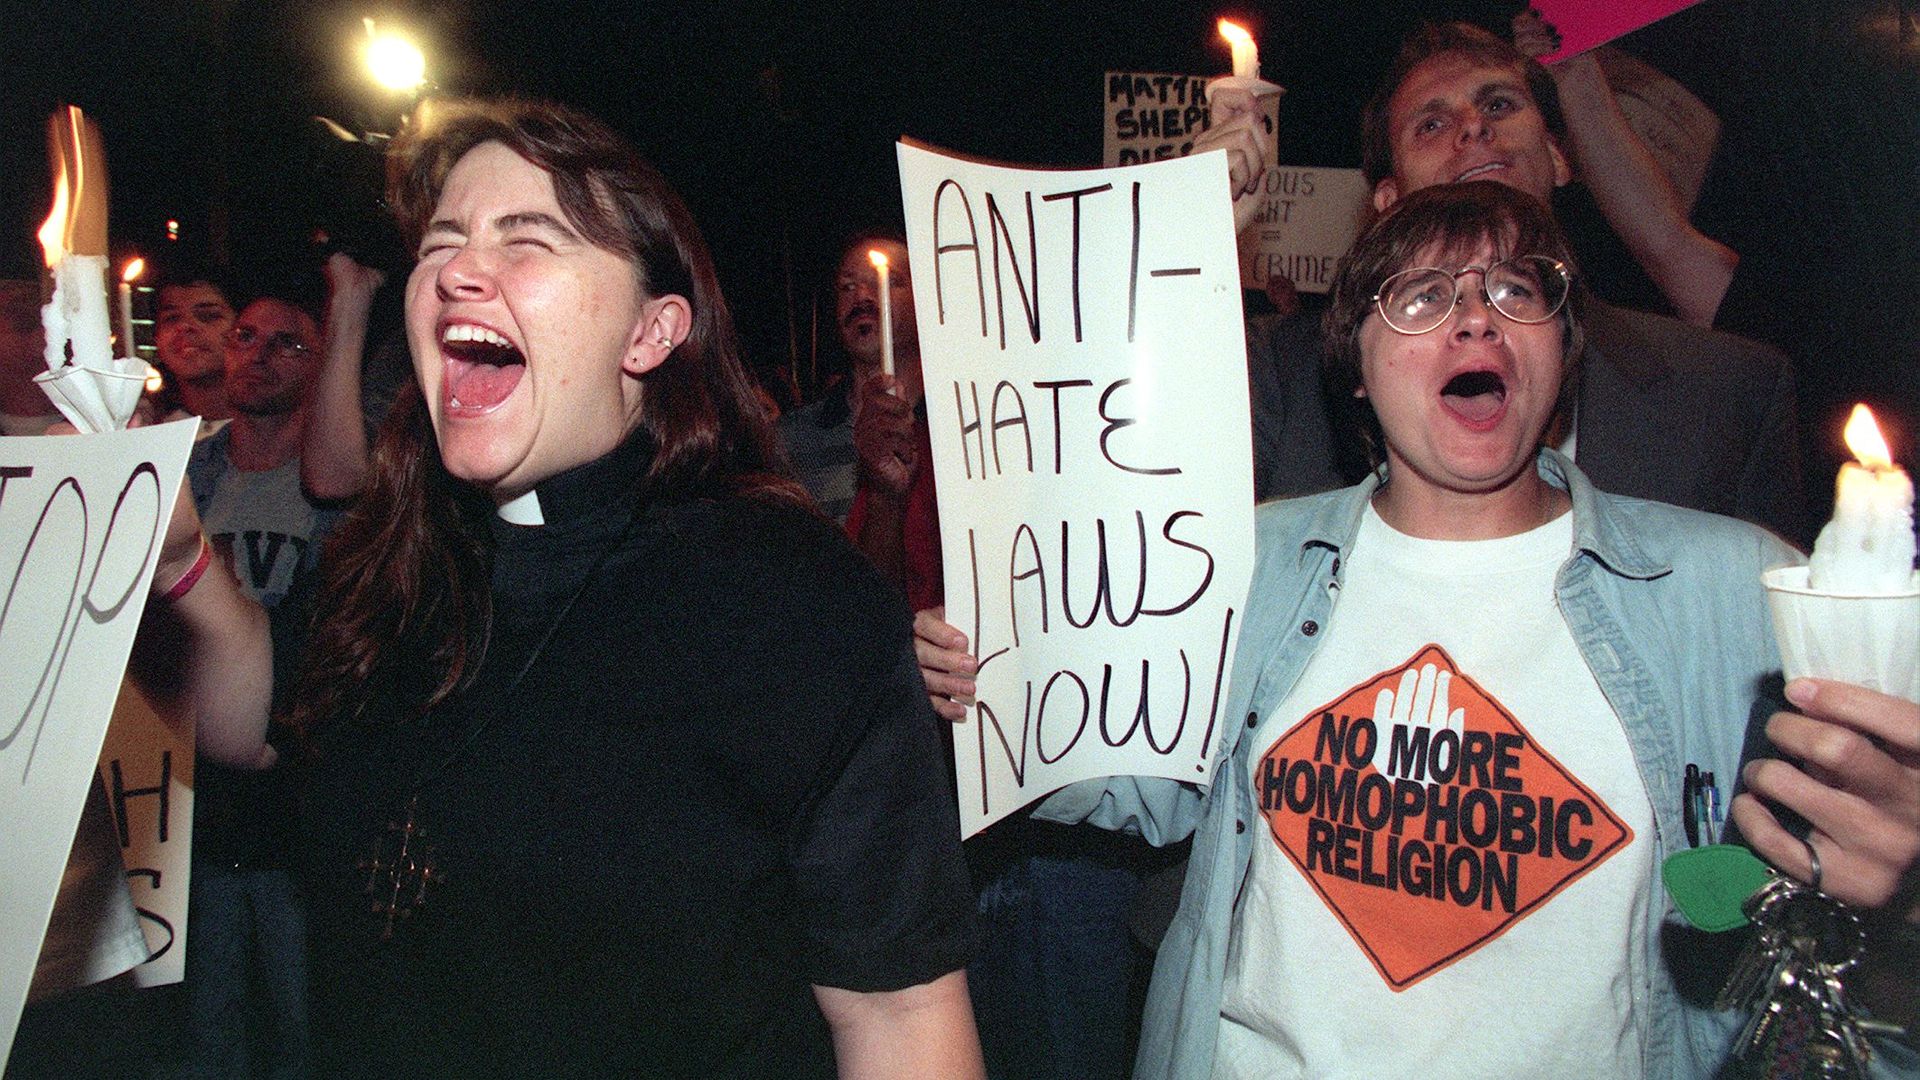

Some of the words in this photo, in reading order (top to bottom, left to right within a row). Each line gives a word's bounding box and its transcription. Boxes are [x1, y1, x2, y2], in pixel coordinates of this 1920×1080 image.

[1264, 171, 1315, 196] OUS
[933, 179, 1201, 350] ANTI-
[954, 377, 1182, 480] HATE
[968, 509, 1215, 675] LAWS
[975, 607, 1234, 816] NOW!
[1313, 712, 1378, 769] NO
[1387, 723, 1524, 792] MORE
[1263, 756, 1594, 861] HOMOPHOBIC
[1306, 817, 1518, 913] RELIGION
